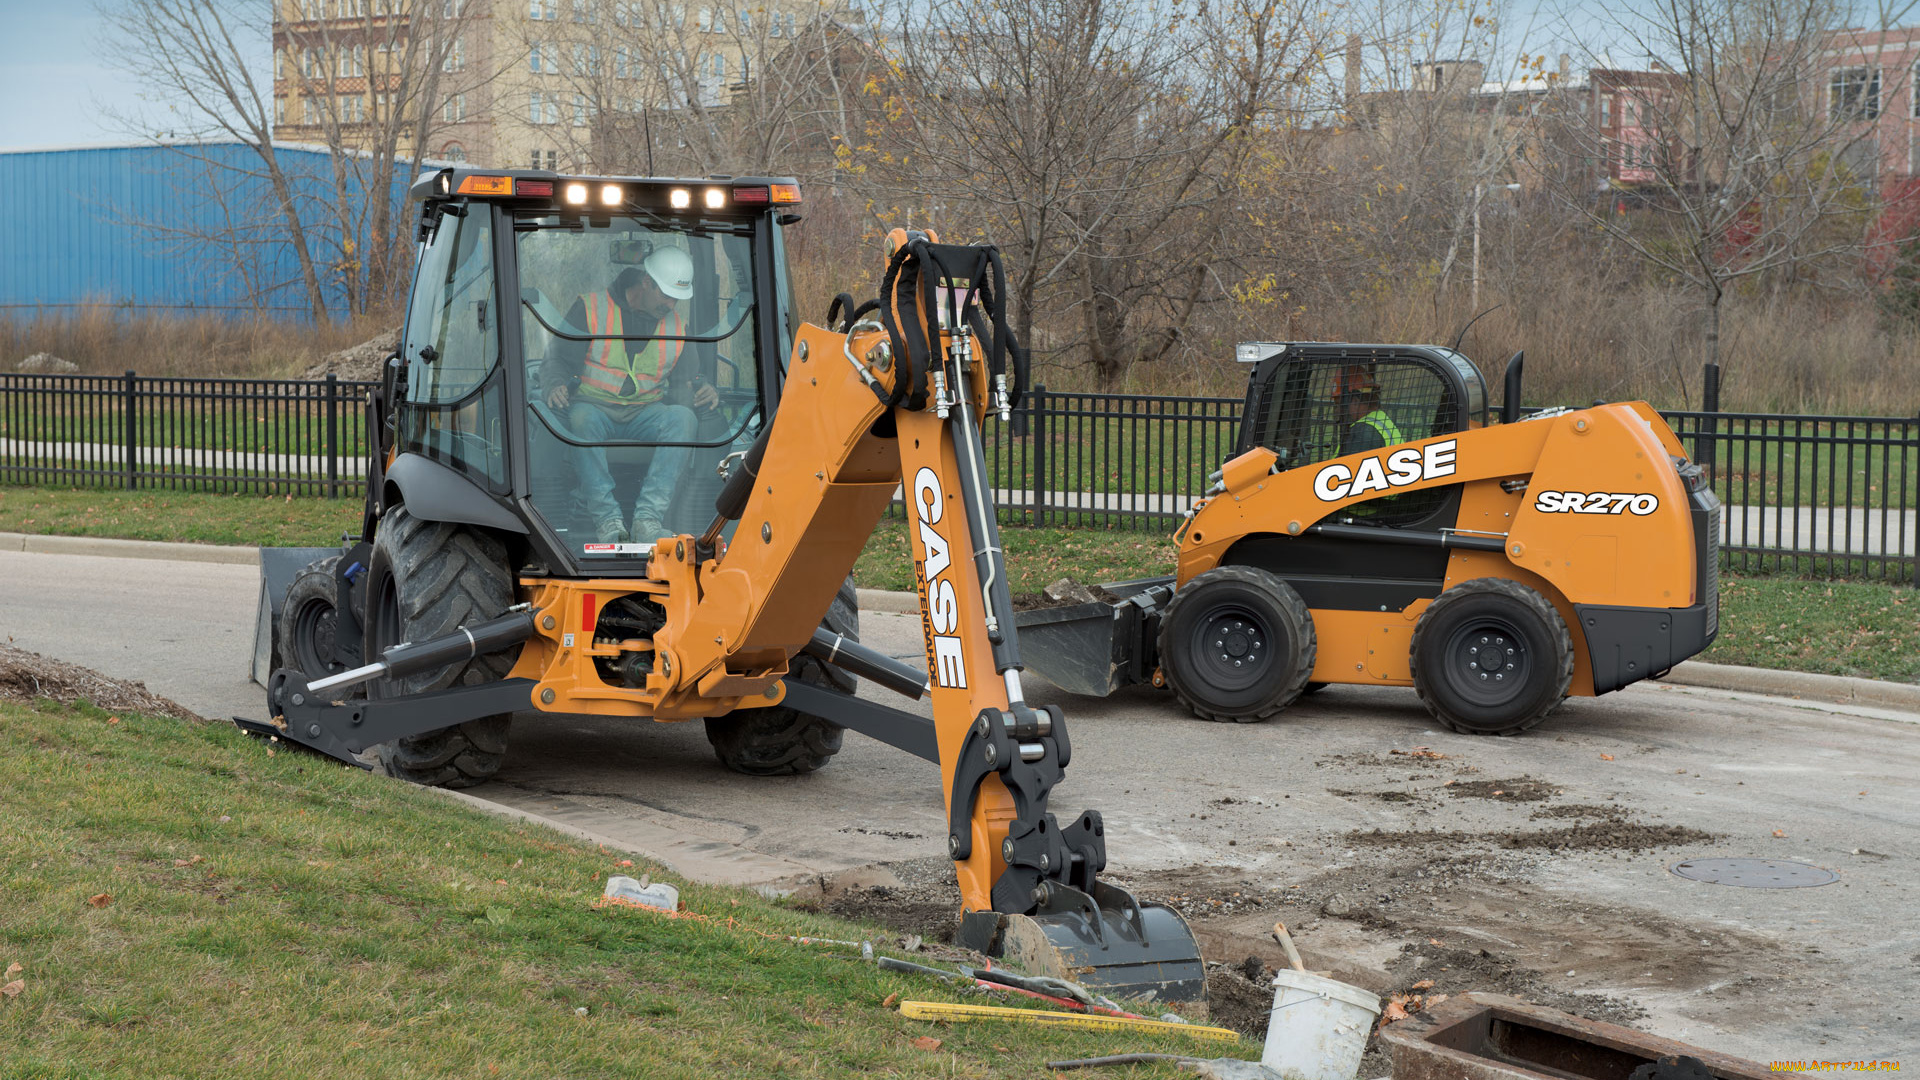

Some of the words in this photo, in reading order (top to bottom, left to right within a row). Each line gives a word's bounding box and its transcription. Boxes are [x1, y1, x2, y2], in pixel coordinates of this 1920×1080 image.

[1313, 438, 1458, 502] CASE
[1534, 490, 1660, 516] SR270
[914, 466, 967, 690] CASE
[915, 560, 939, 688] EXTENDAHOE
